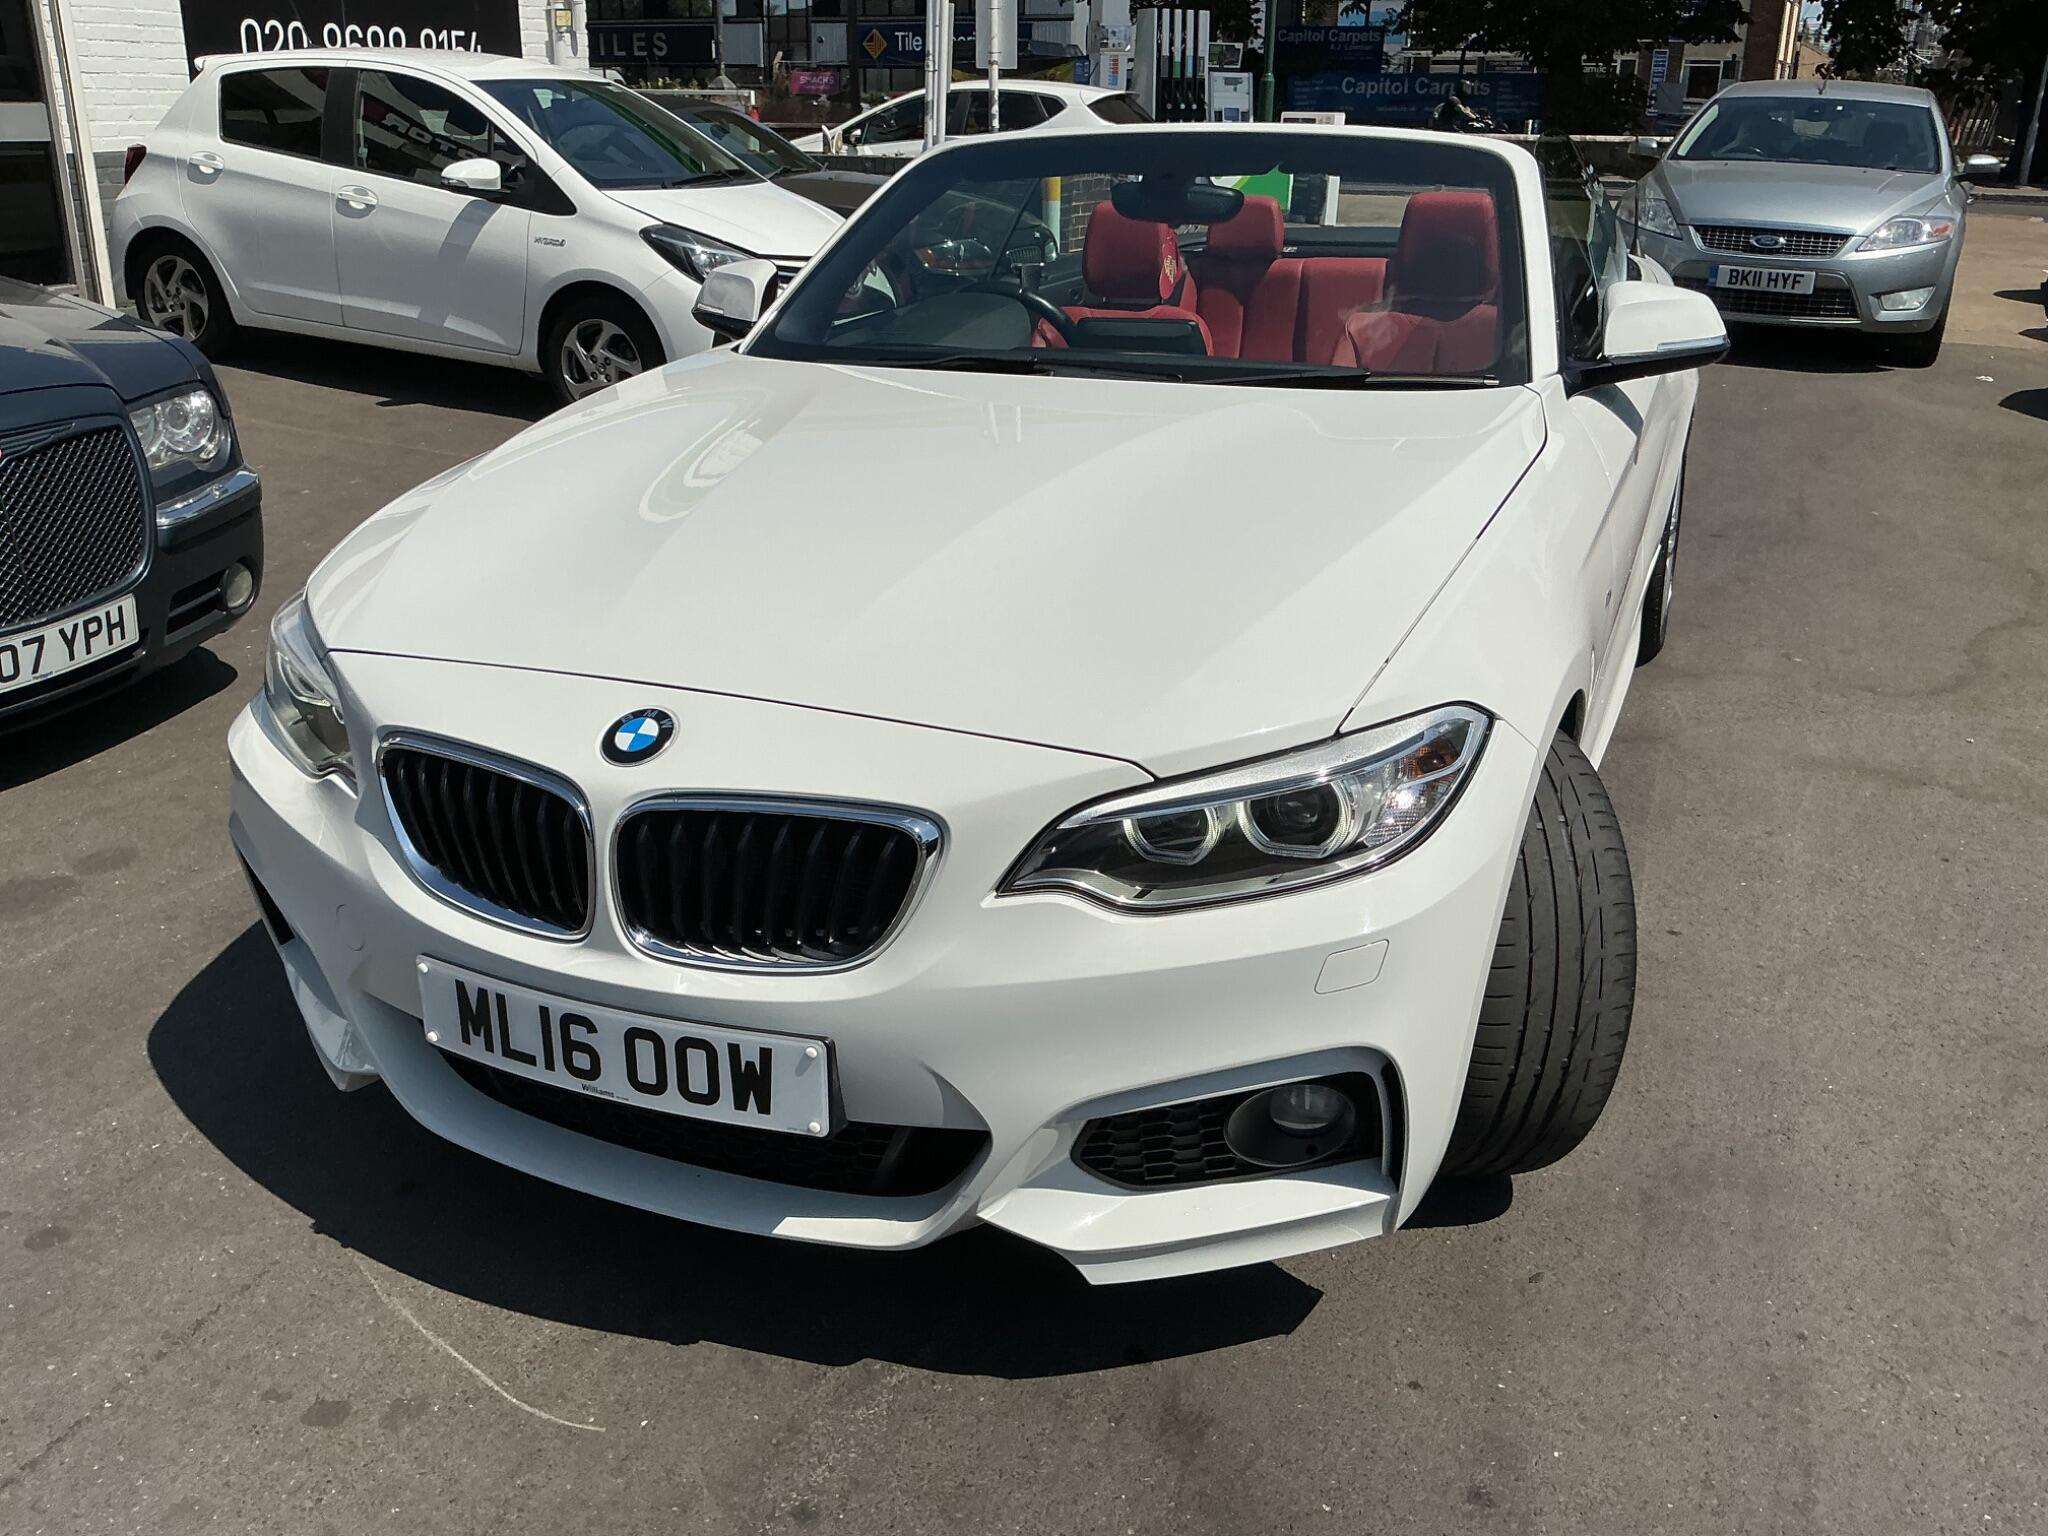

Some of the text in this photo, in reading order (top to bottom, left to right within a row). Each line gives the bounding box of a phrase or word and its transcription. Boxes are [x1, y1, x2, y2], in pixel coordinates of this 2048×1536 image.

[239, 18, 308, 53] 020
[894, 31, 923, 51] Tile
[1277, 29, 1382, 44] Capitol Carpets
[1341, 76, 1409, 98] Capitol
[1414, 77, 1491, 96] Carpts
[1727, 268, 1805, 290] BK11 HYF
[58, 604, 127, 662] YPH
[620, 709, 674, 729] BMW
[454, 978, 602, 1083] ML16
